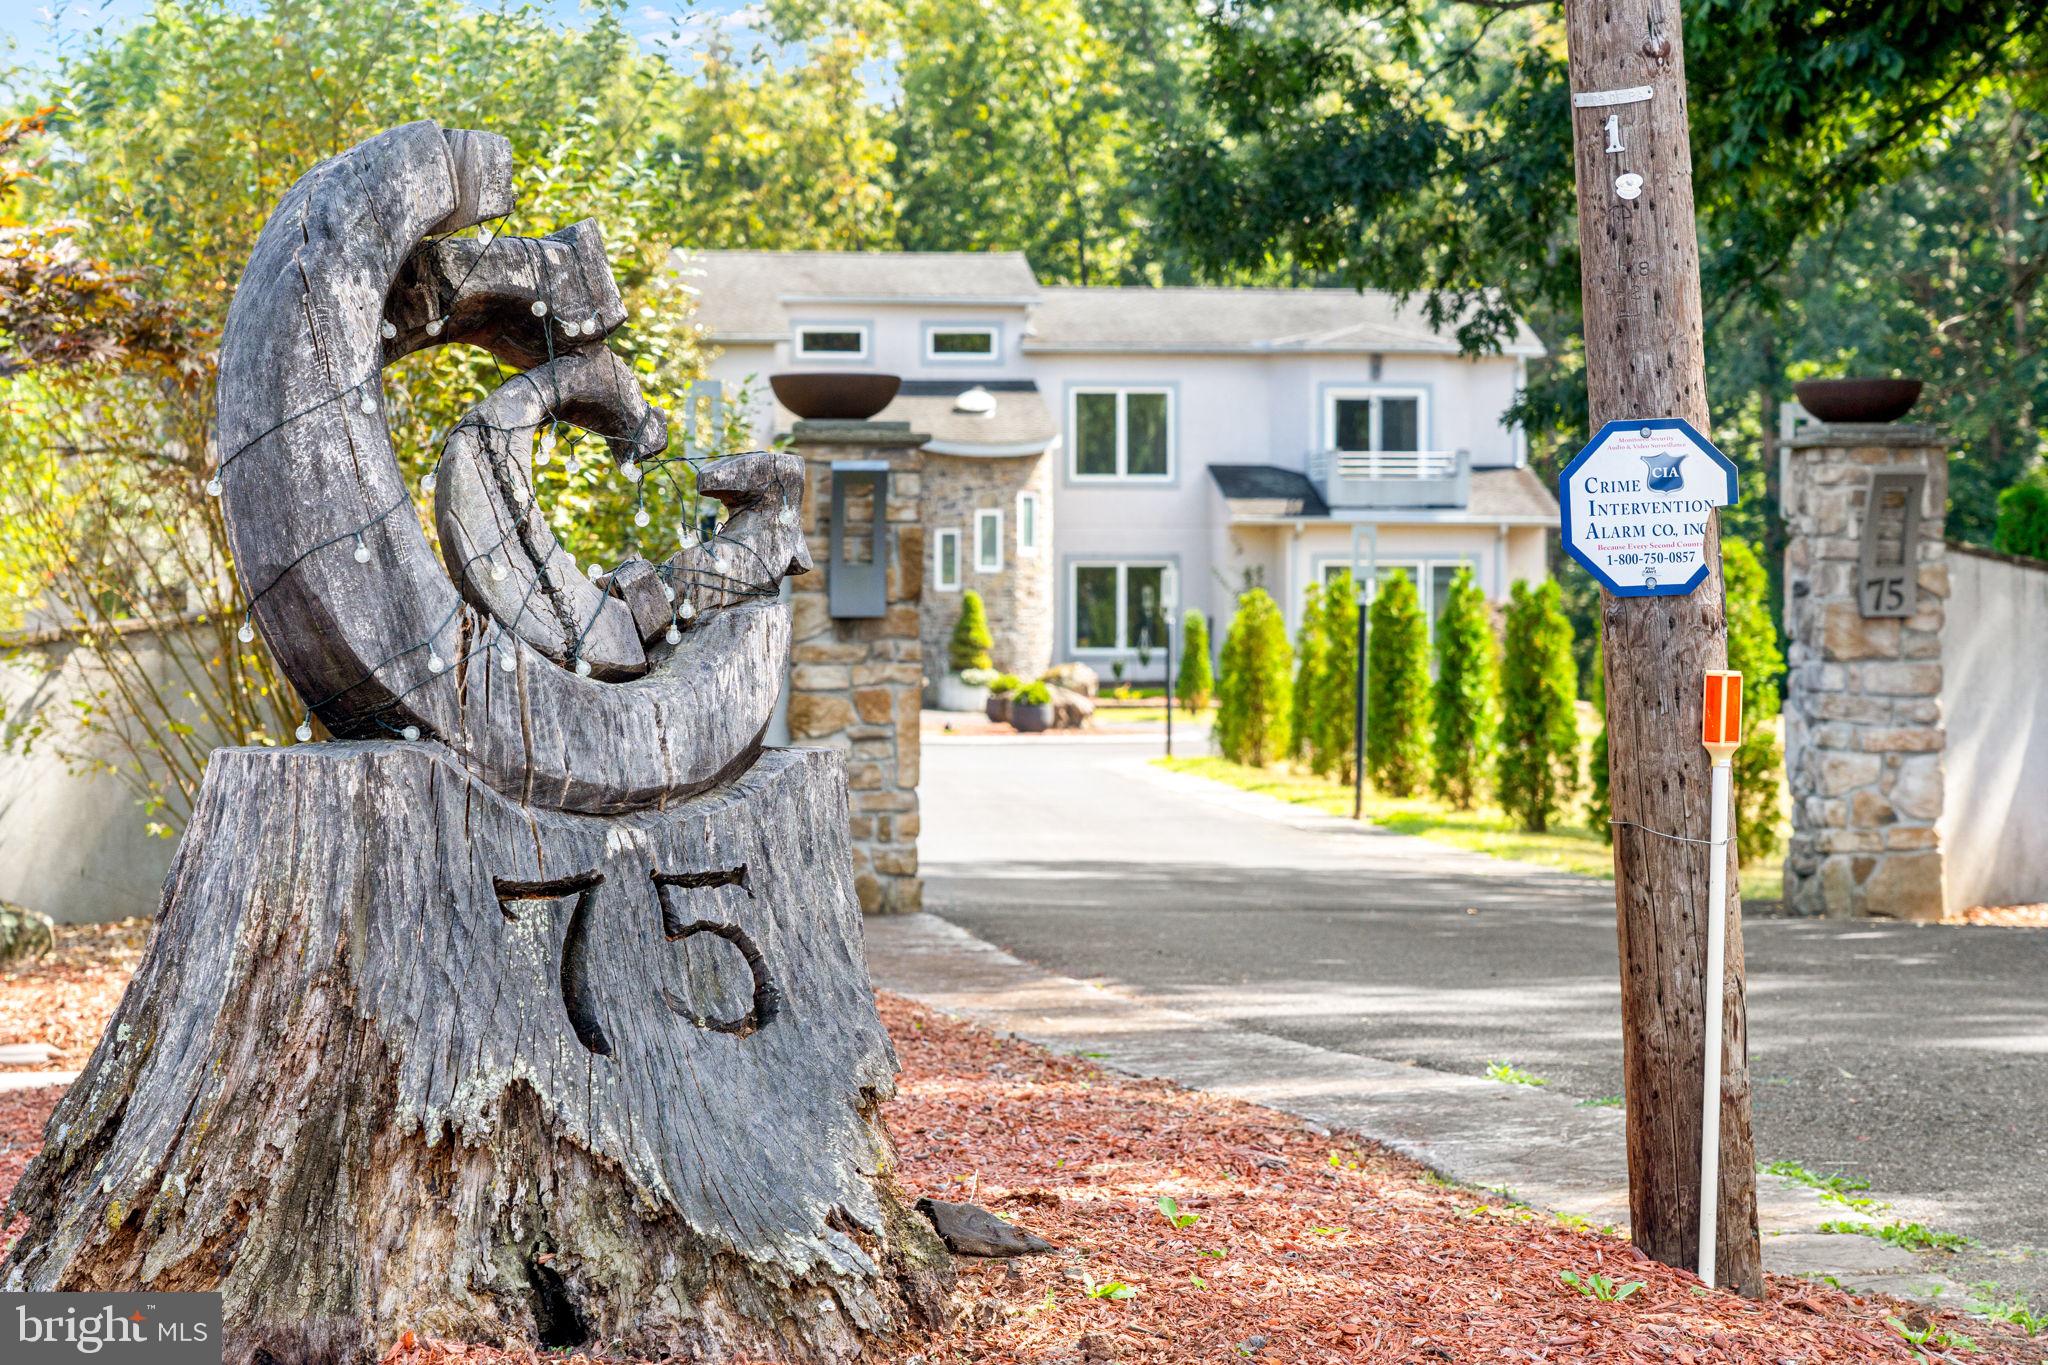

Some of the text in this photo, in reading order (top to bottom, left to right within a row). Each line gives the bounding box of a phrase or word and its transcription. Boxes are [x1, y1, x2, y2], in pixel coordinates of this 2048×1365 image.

[1652, 467, 1679, 478] CIA
[1584, 477, 1641, 494] CRIME
[1588, 499, 1715, 517] INTERVENTION
[1585, 522, 1646, 540] ALARM
[1607, 551, 1695, 566] 1-800-750-0857
[1866, 577, 1905, 611] 75
[492, 862, 781, 1063] 75
